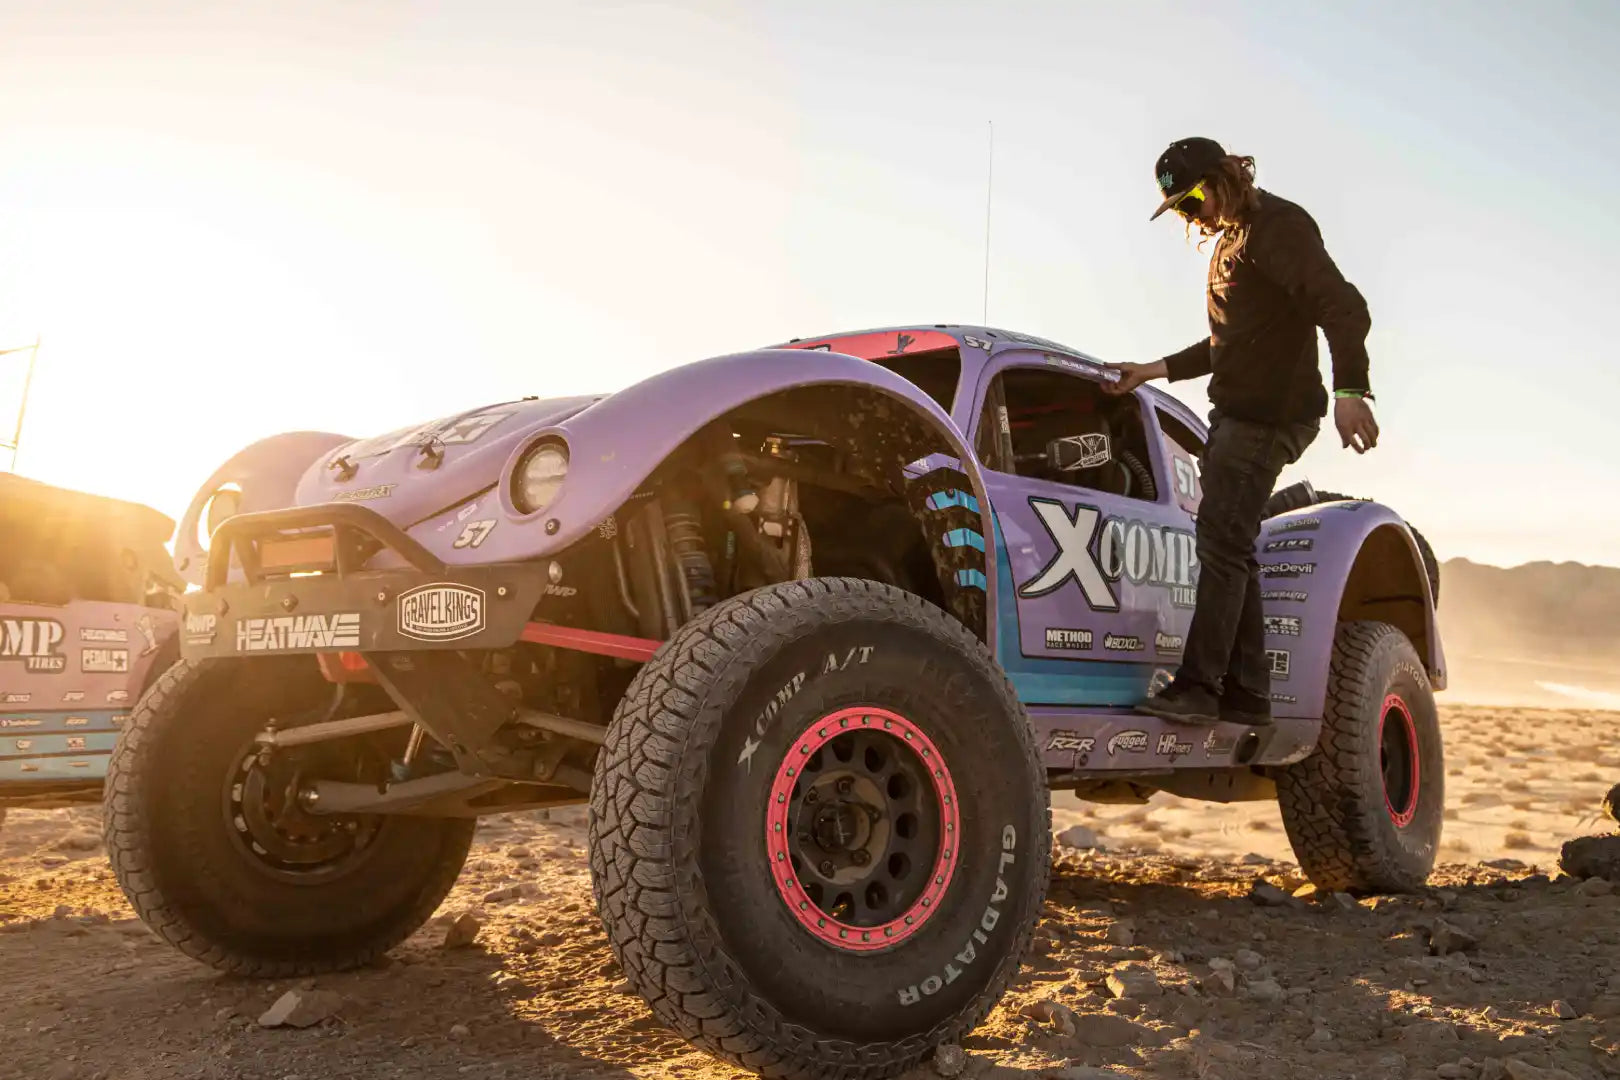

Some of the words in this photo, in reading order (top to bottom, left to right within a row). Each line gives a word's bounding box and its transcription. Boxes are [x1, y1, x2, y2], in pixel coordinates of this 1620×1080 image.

[1174, 456, 1196, 500] 57
[453, 520, 498, 549] 57
[404, 589, 479, 629] GRAVELKINGS
[1172, 587, 1197, 605] TIRE
[0, 619, 63, 656] MP
[236, 612, 361, 652] HEATWAVE
[1046, 629, 1092, 643] METHOD
[28, 657, 64, 669] TIRES
[823, 646, 875, 675] A/T
[1047, 736, 1096, 751] RZR
[898, 824, 1017, 1006] GLADIATOR
